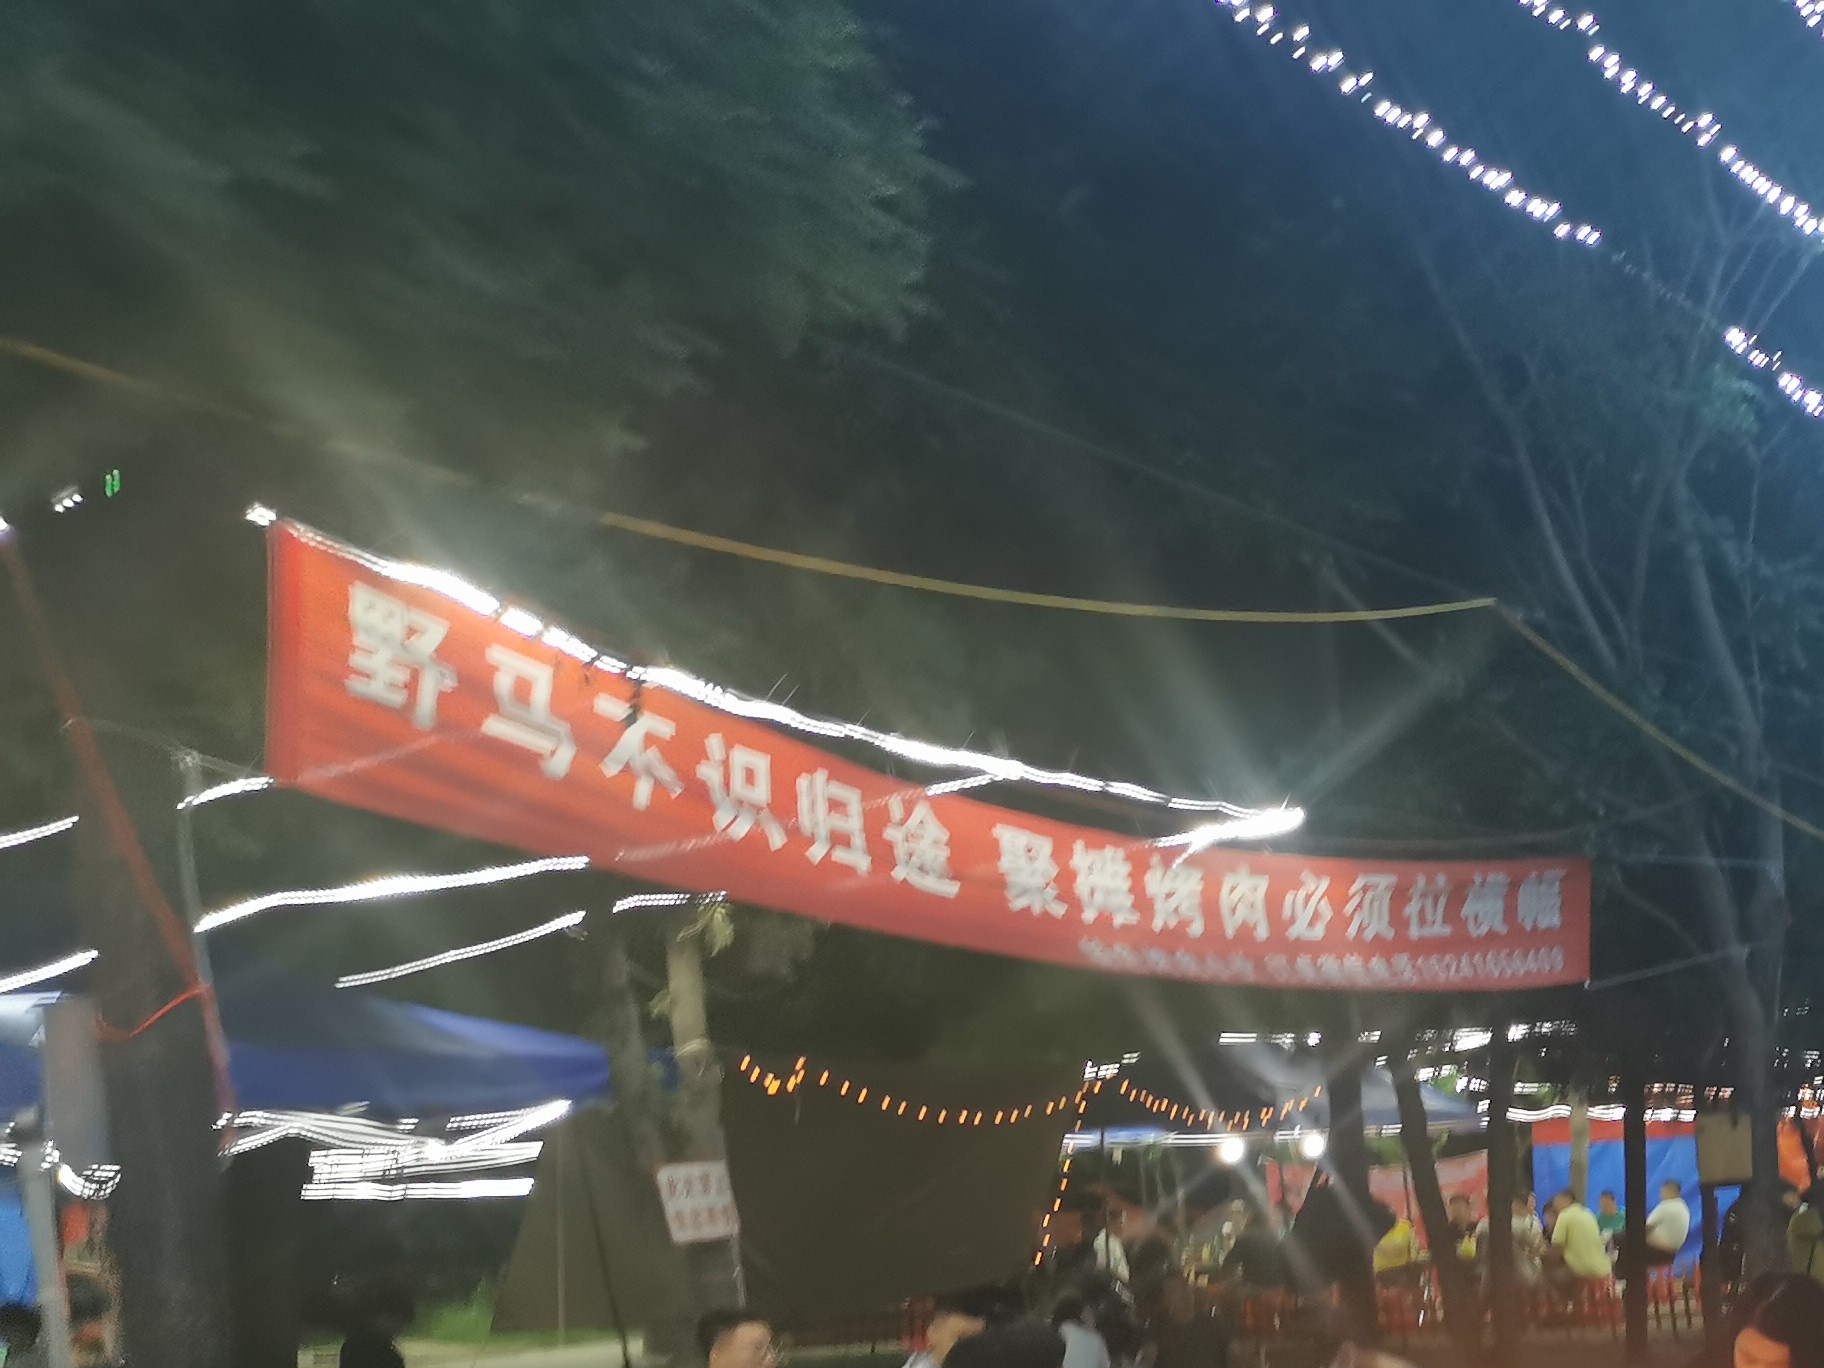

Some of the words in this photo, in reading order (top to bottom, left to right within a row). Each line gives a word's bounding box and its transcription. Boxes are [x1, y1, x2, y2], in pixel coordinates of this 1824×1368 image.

[345, 580, 961, 899] 野马不识归途
